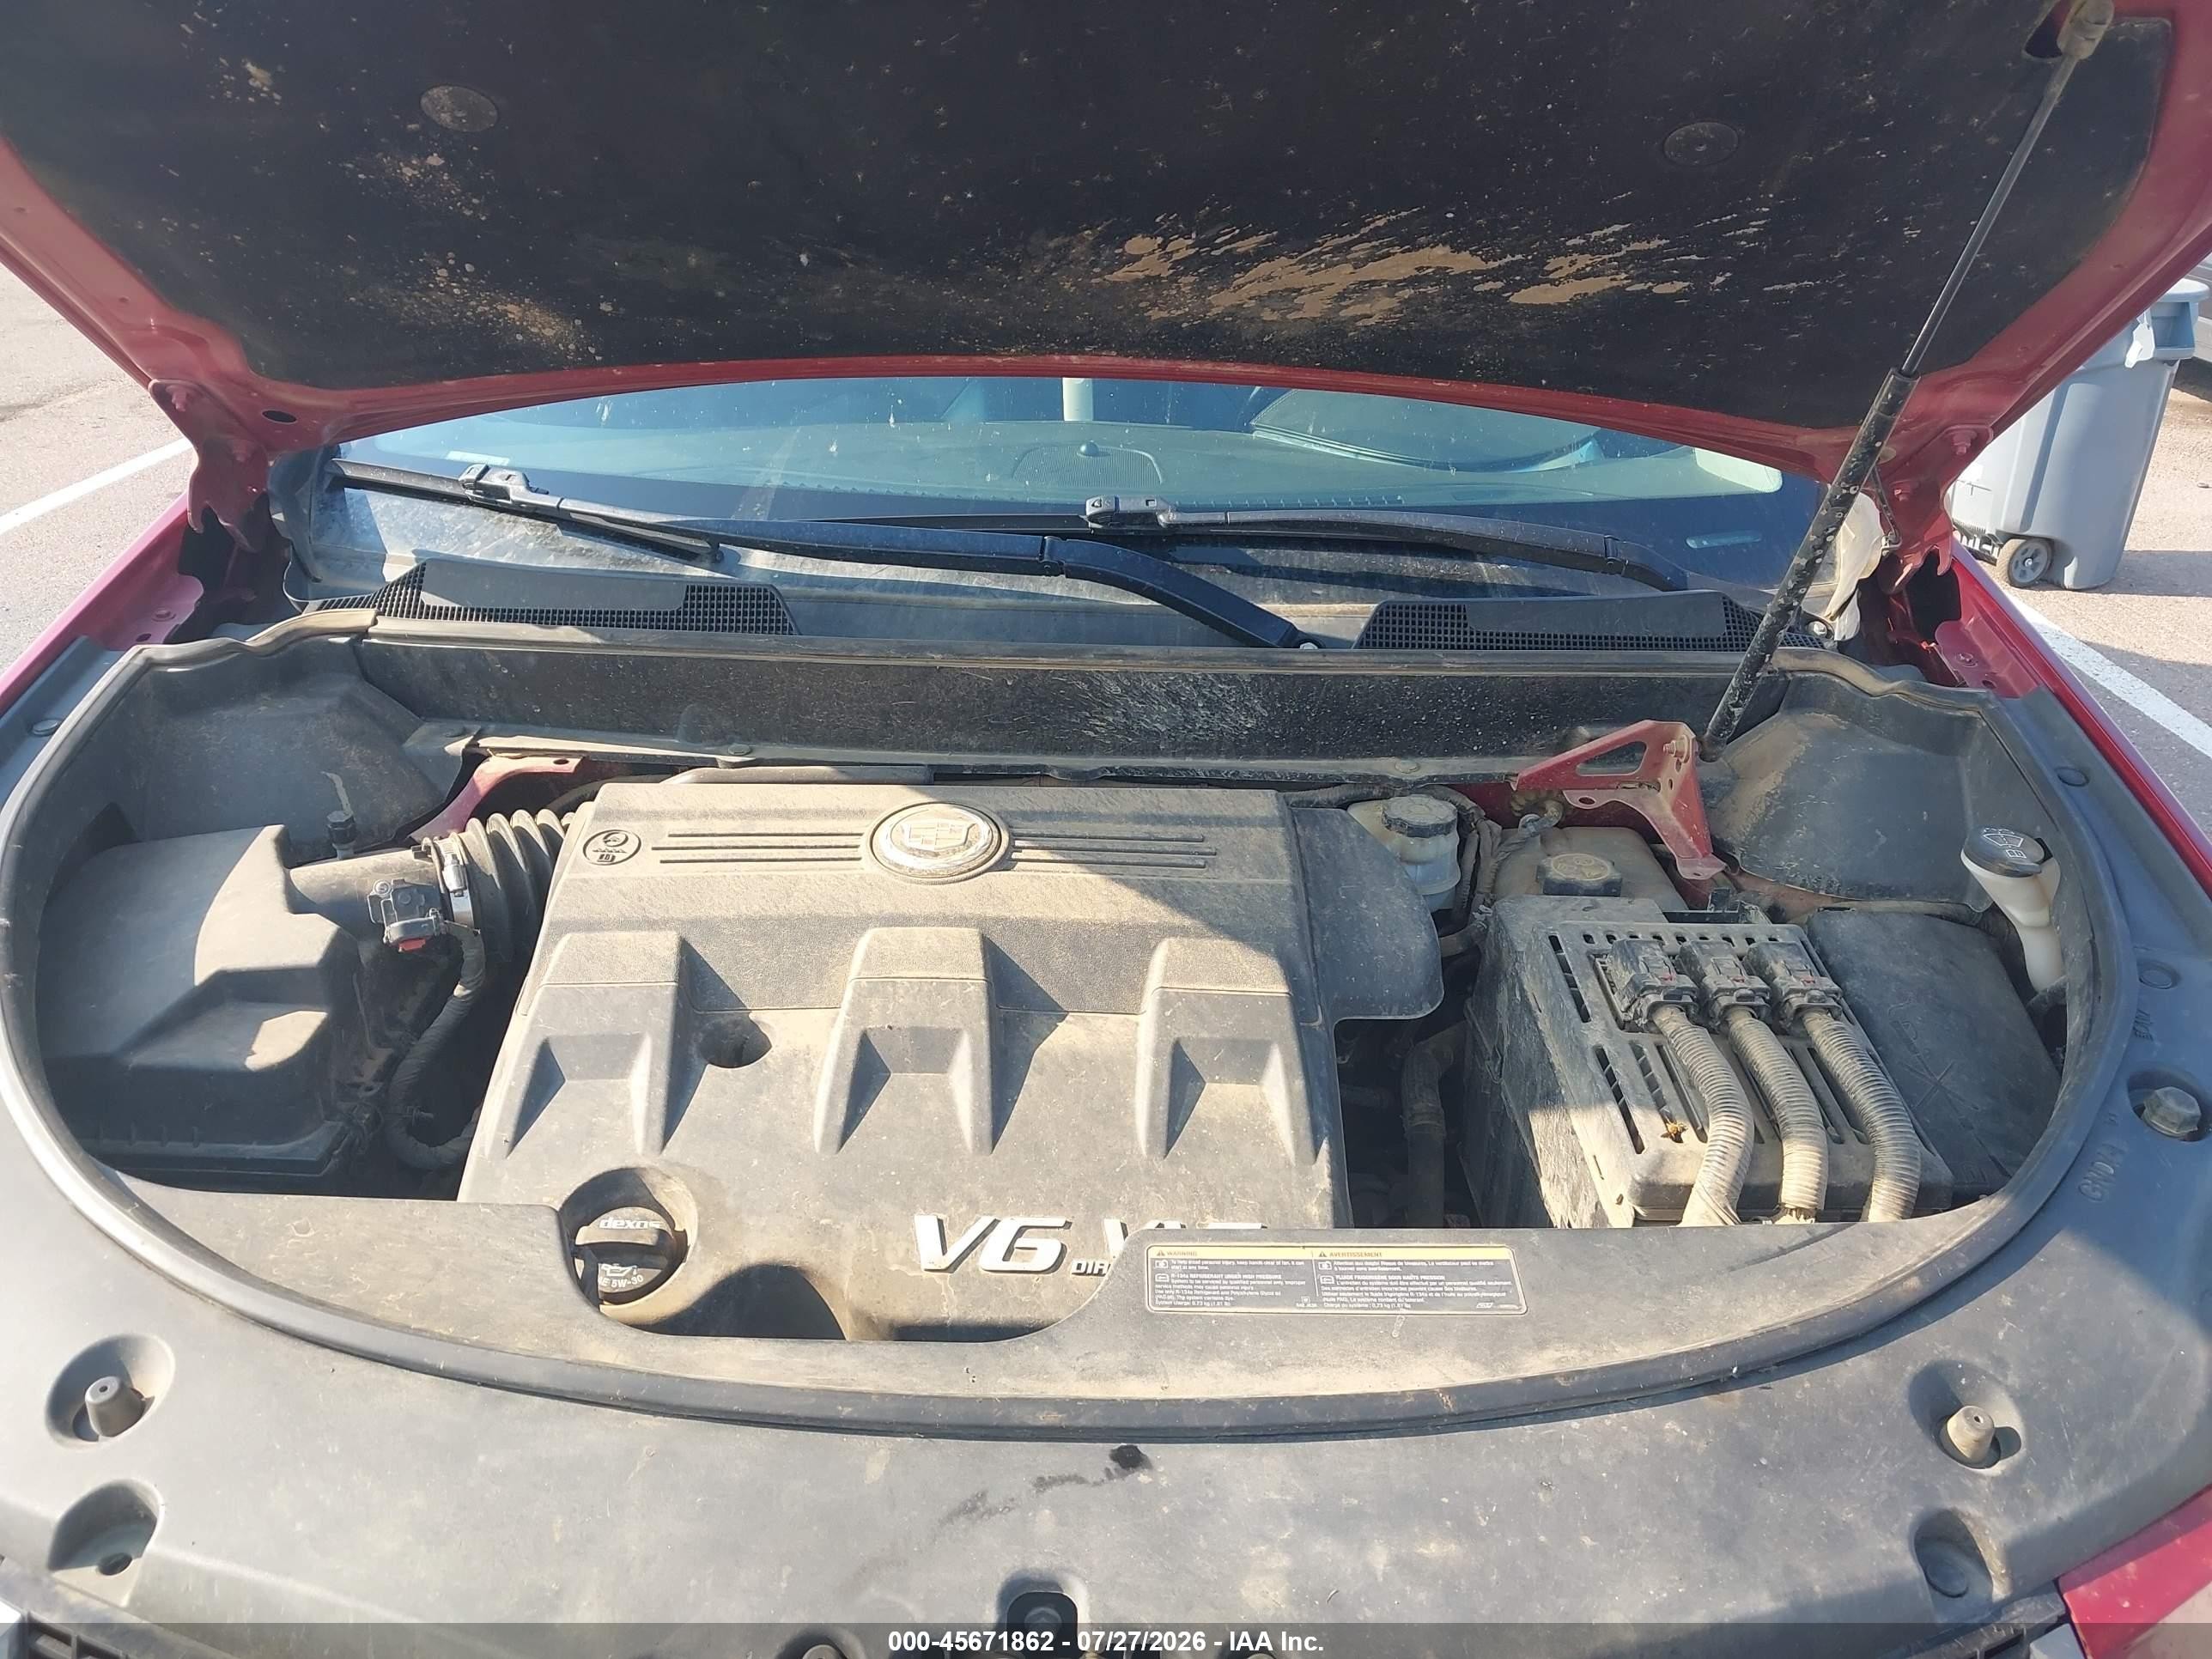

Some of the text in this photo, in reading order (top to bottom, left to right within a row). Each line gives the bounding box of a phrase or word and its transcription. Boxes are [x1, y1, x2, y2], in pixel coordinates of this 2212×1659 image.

[599, 1216, 661, 1230] dexos
[914, 1213, 1073, 1274] V6
[611, 1274, 644, 1288] 5W-30
